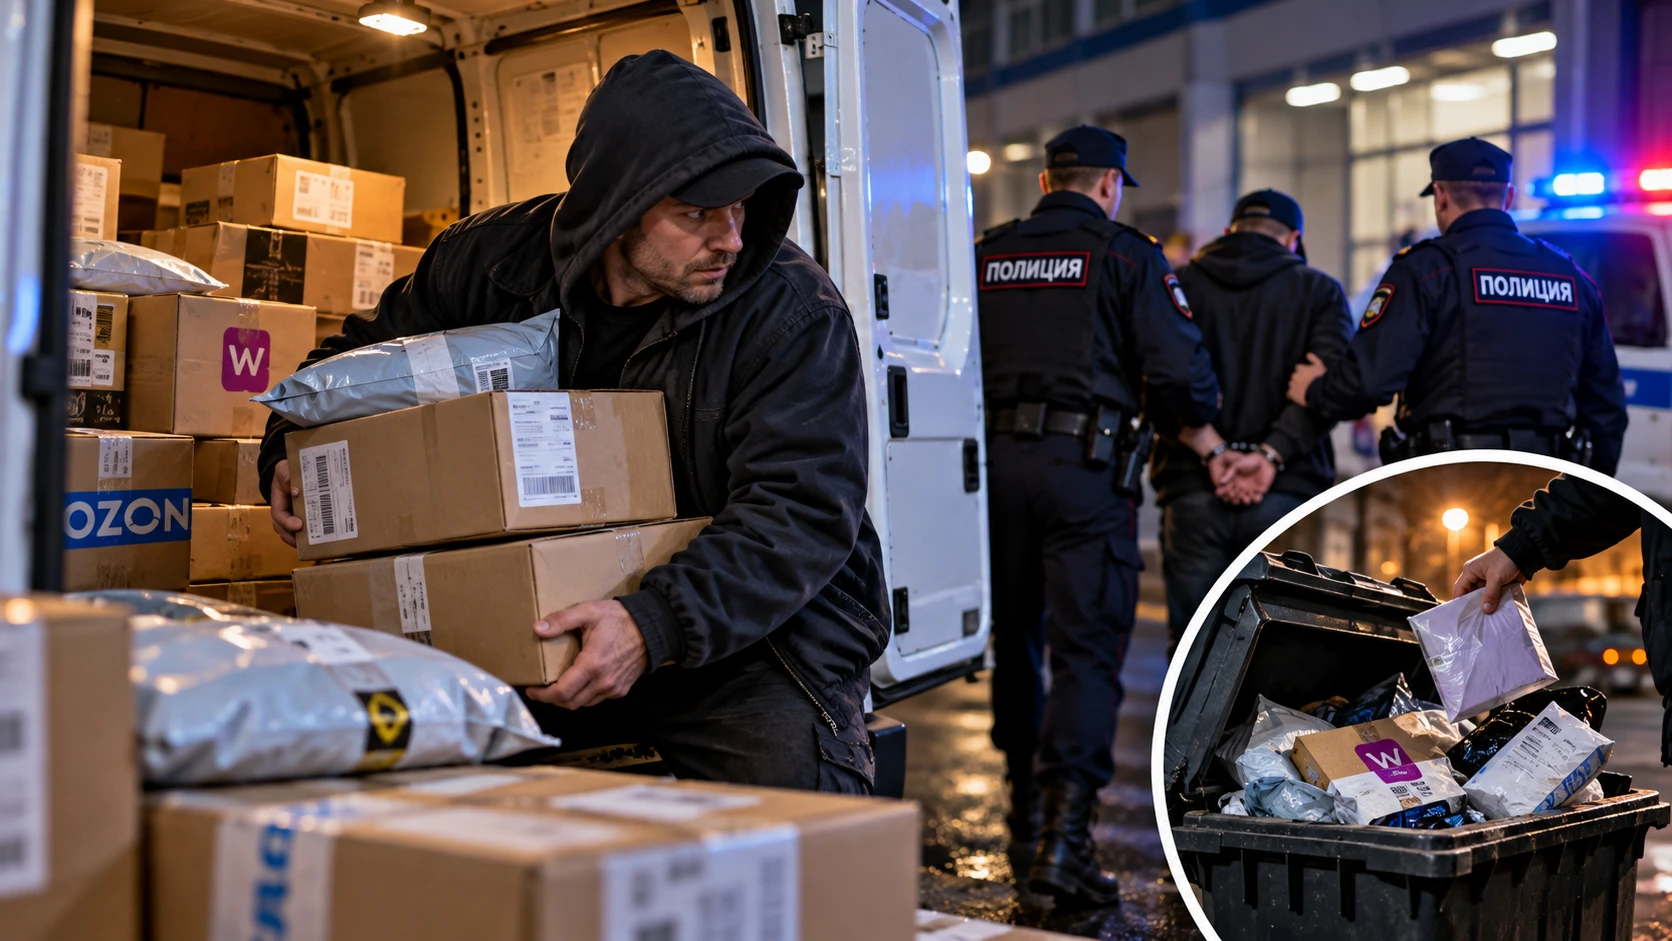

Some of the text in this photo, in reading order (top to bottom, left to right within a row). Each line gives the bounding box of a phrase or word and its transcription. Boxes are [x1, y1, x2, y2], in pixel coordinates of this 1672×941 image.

[986, 258, 1083, 283] ПОЛИЦИЯ
[1480, 275, 1573, 303] ПОЛИЦИЯ
[228, 344, 265, 377] W
[64, 498, 189, 539] OZON
[1365, 747, 1403, 769] W
